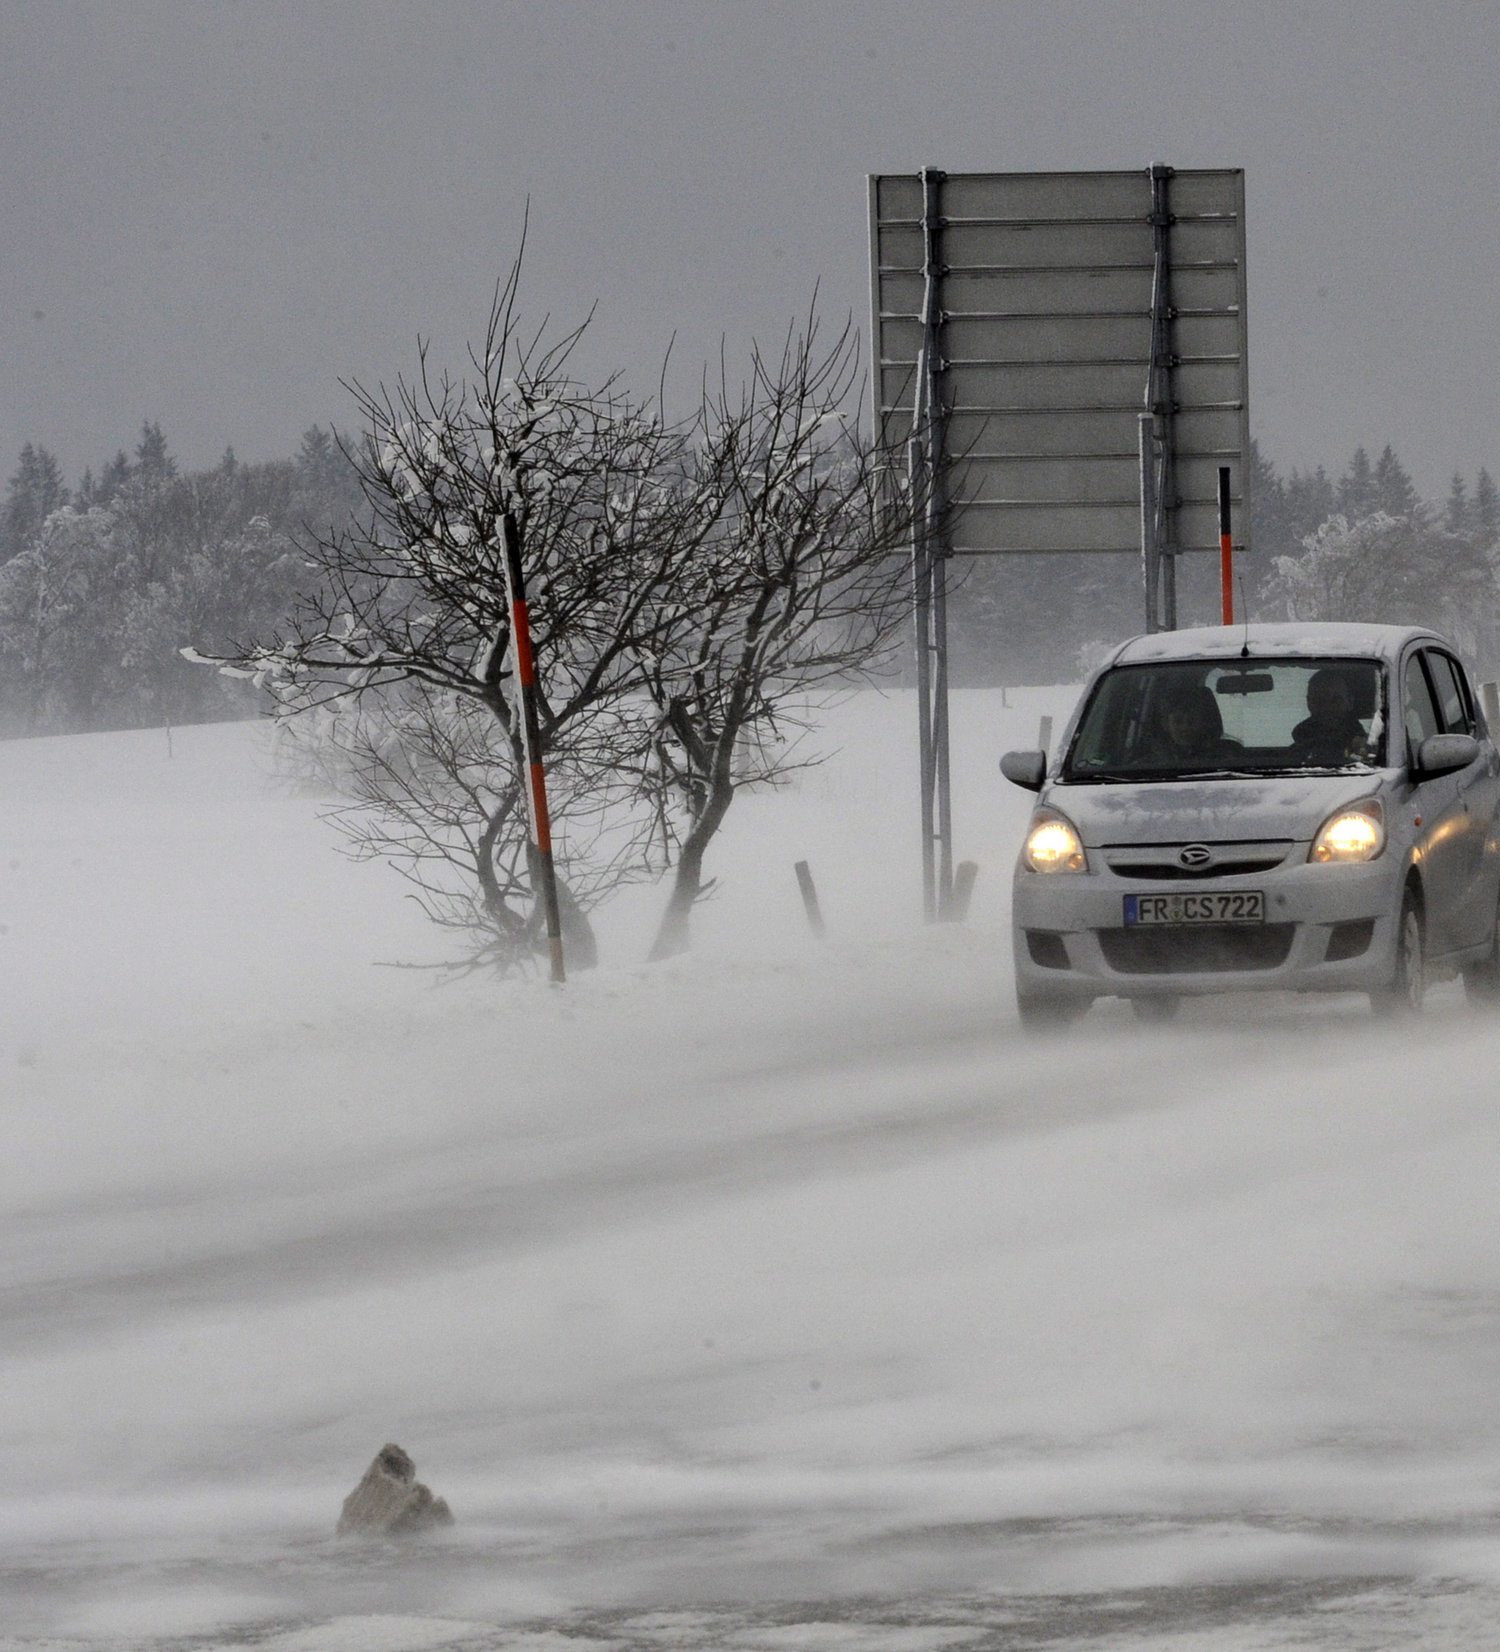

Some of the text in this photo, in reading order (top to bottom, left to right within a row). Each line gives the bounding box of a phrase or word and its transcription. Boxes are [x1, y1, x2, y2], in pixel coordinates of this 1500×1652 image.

[1139, 895, 1260, 921] FR CS 722
